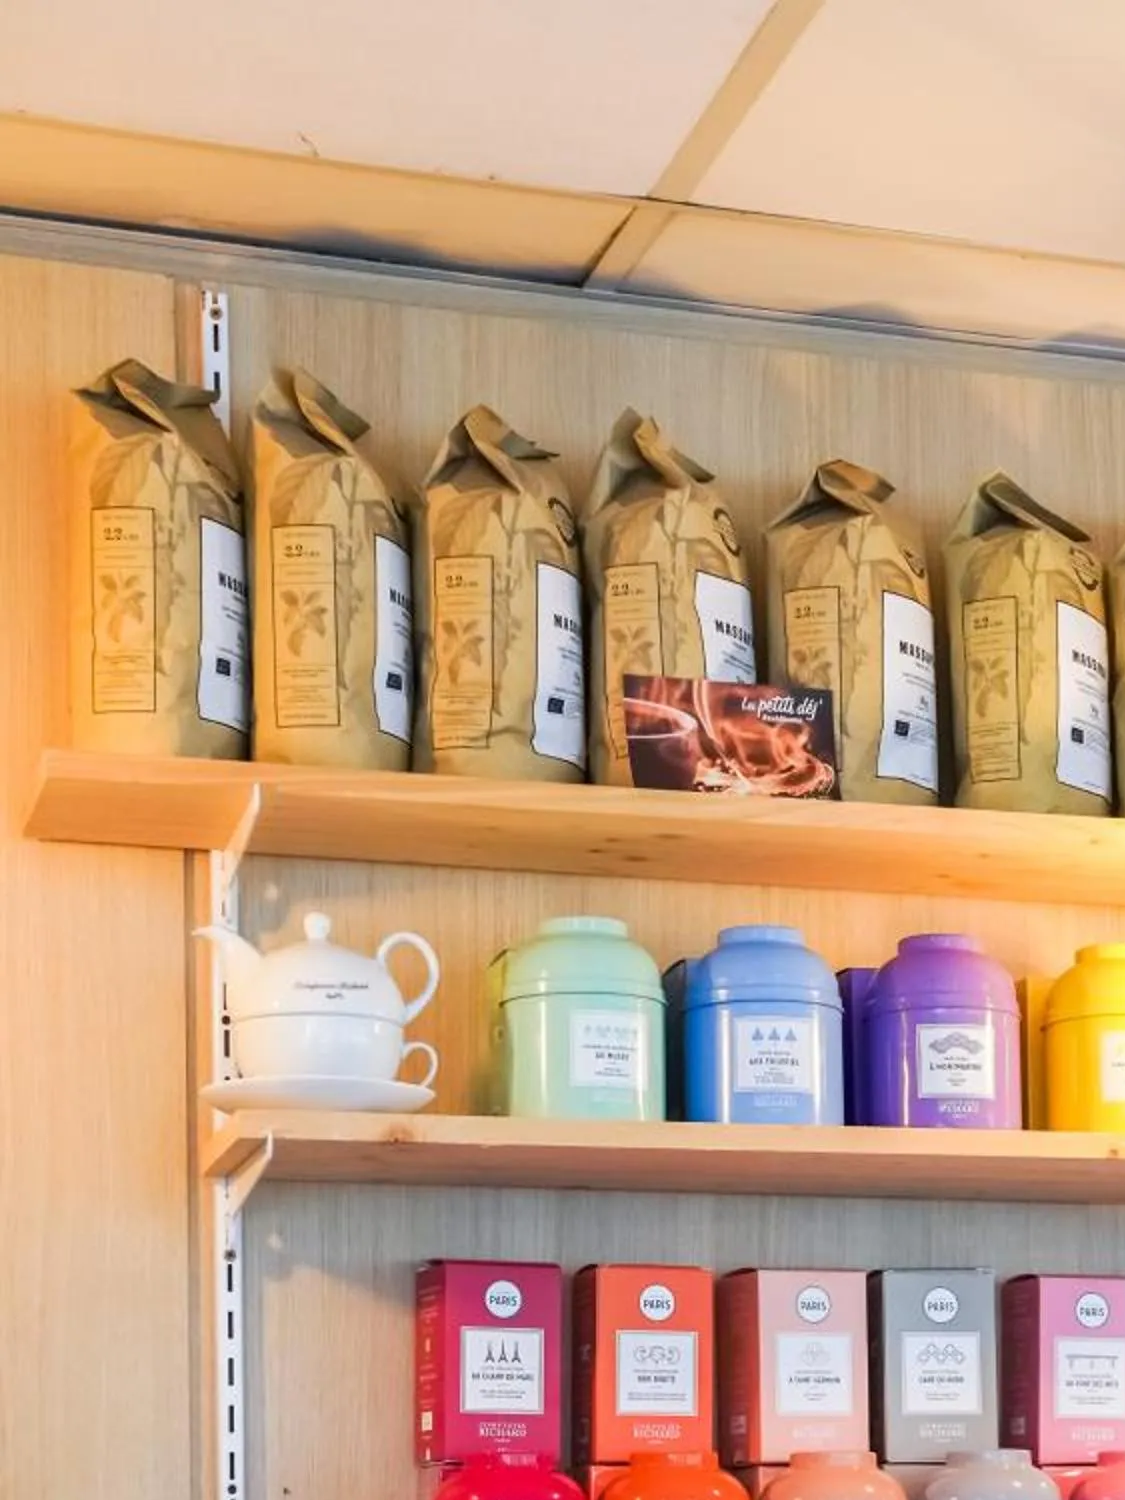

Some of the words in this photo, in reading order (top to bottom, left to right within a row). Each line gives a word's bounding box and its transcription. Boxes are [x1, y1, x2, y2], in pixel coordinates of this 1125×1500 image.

[757, 695, 795, 719] petits
[489, 1294, 518, 1307] PARIS
[643, 1298, 672, 1311] PARIS
[801, 1299, 828, 1311] PARIS
[927, 1302, 956, 1313] PARIS
[1079, 1306, 1106, 1318] PARIS
